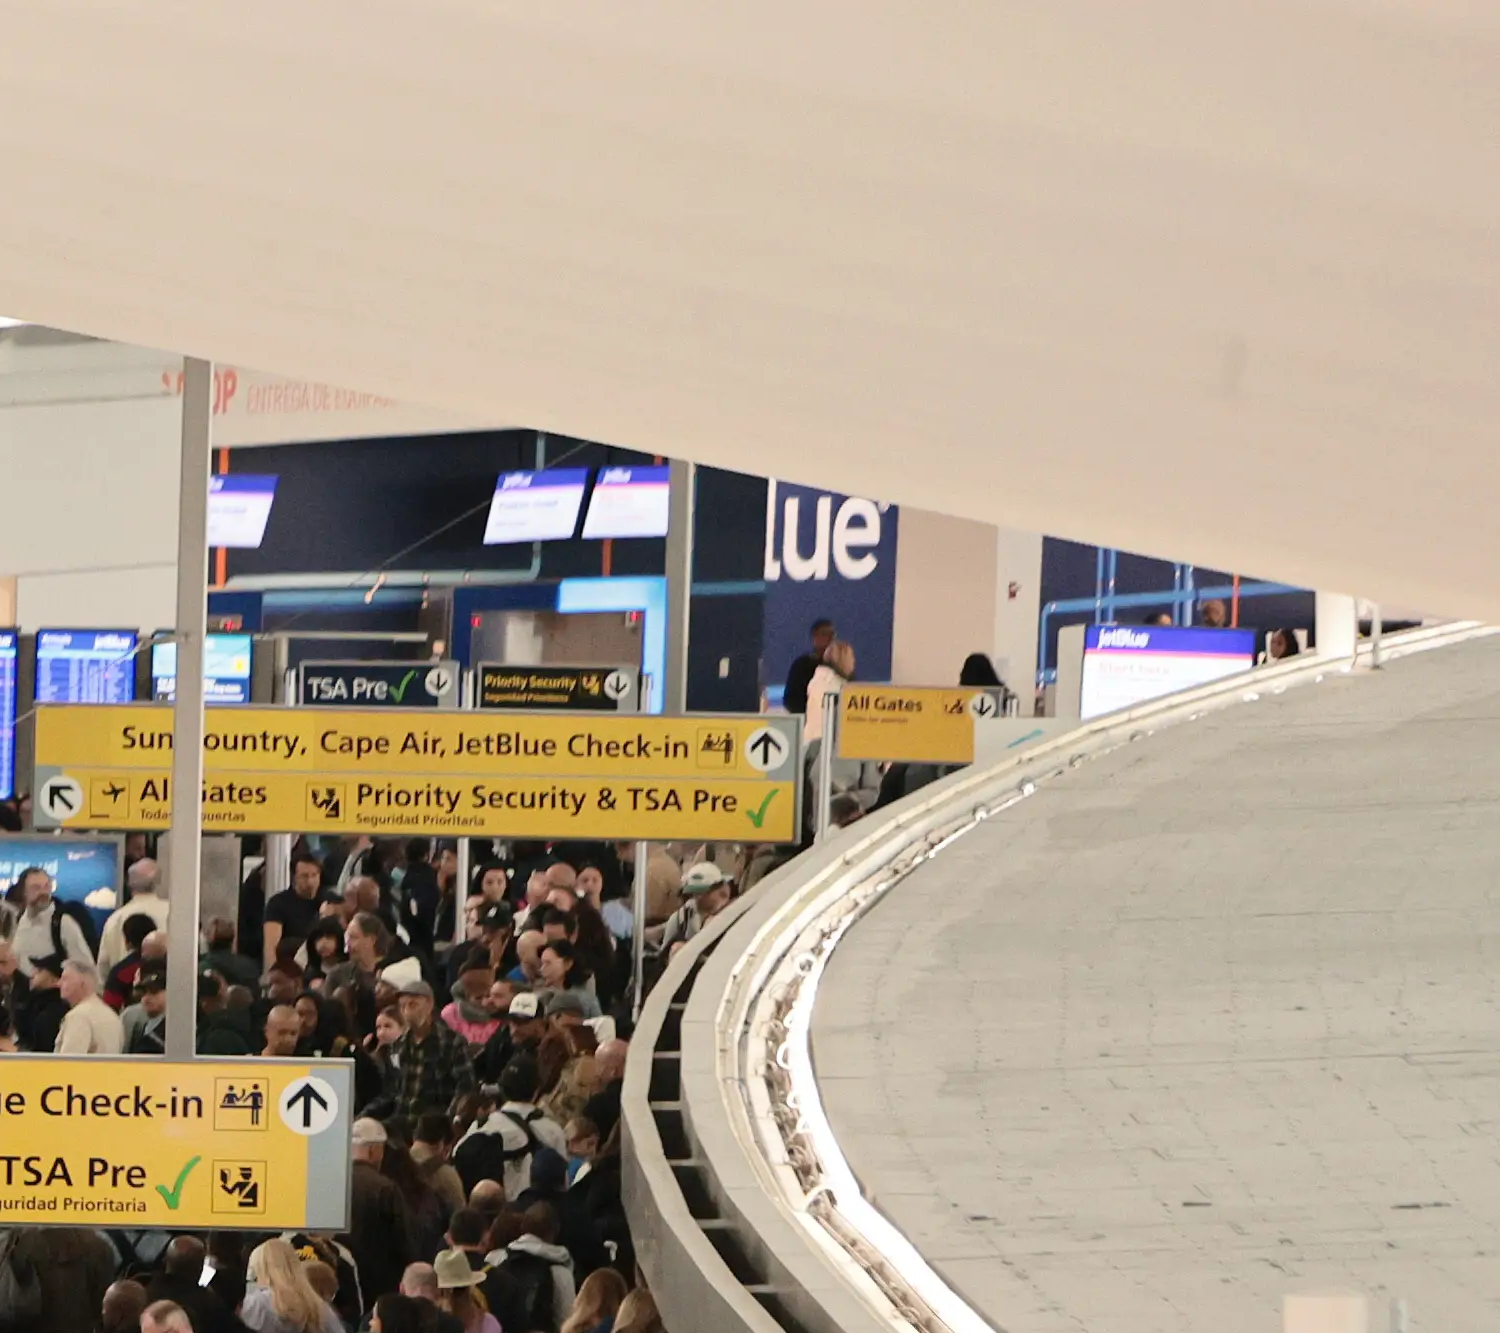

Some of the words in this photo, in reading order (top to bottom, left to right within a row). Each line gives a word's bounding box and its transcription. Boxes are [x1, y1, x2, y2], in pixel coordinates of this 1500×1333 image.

[307, 676, 347, 701] TSA
[352, 676, 388, 701] Pre
[847, 695, 869, 711] All
[874, 696, 923, 713] Gates
[122, 726, 173, 751] Sun
[204, 730, 307, 758] ountry,
[319, 730, 390, 763] Cape
[400, 731, 446, 763] Air,
[453, 732, 558, 759] JetBlue
[567, 733, 689, 762] Check-in
[140, 779, 170, 802] Al
[201, 781, 268, 805] ates
[356, 783, 460, 815] Priority
[472, 784, 590, 816] Security
[597, 787, 617, 811] &
[628, 788, 684, 813] TSA
[693, 789, 738, 815] Pre
[356, 813, 420, 828] Seguridad
[39, 1084, 204, 1119] Check-in
[87, 1158, 148, 1191] Pre
[62, 1195, 148, 1215] Prioritaria
